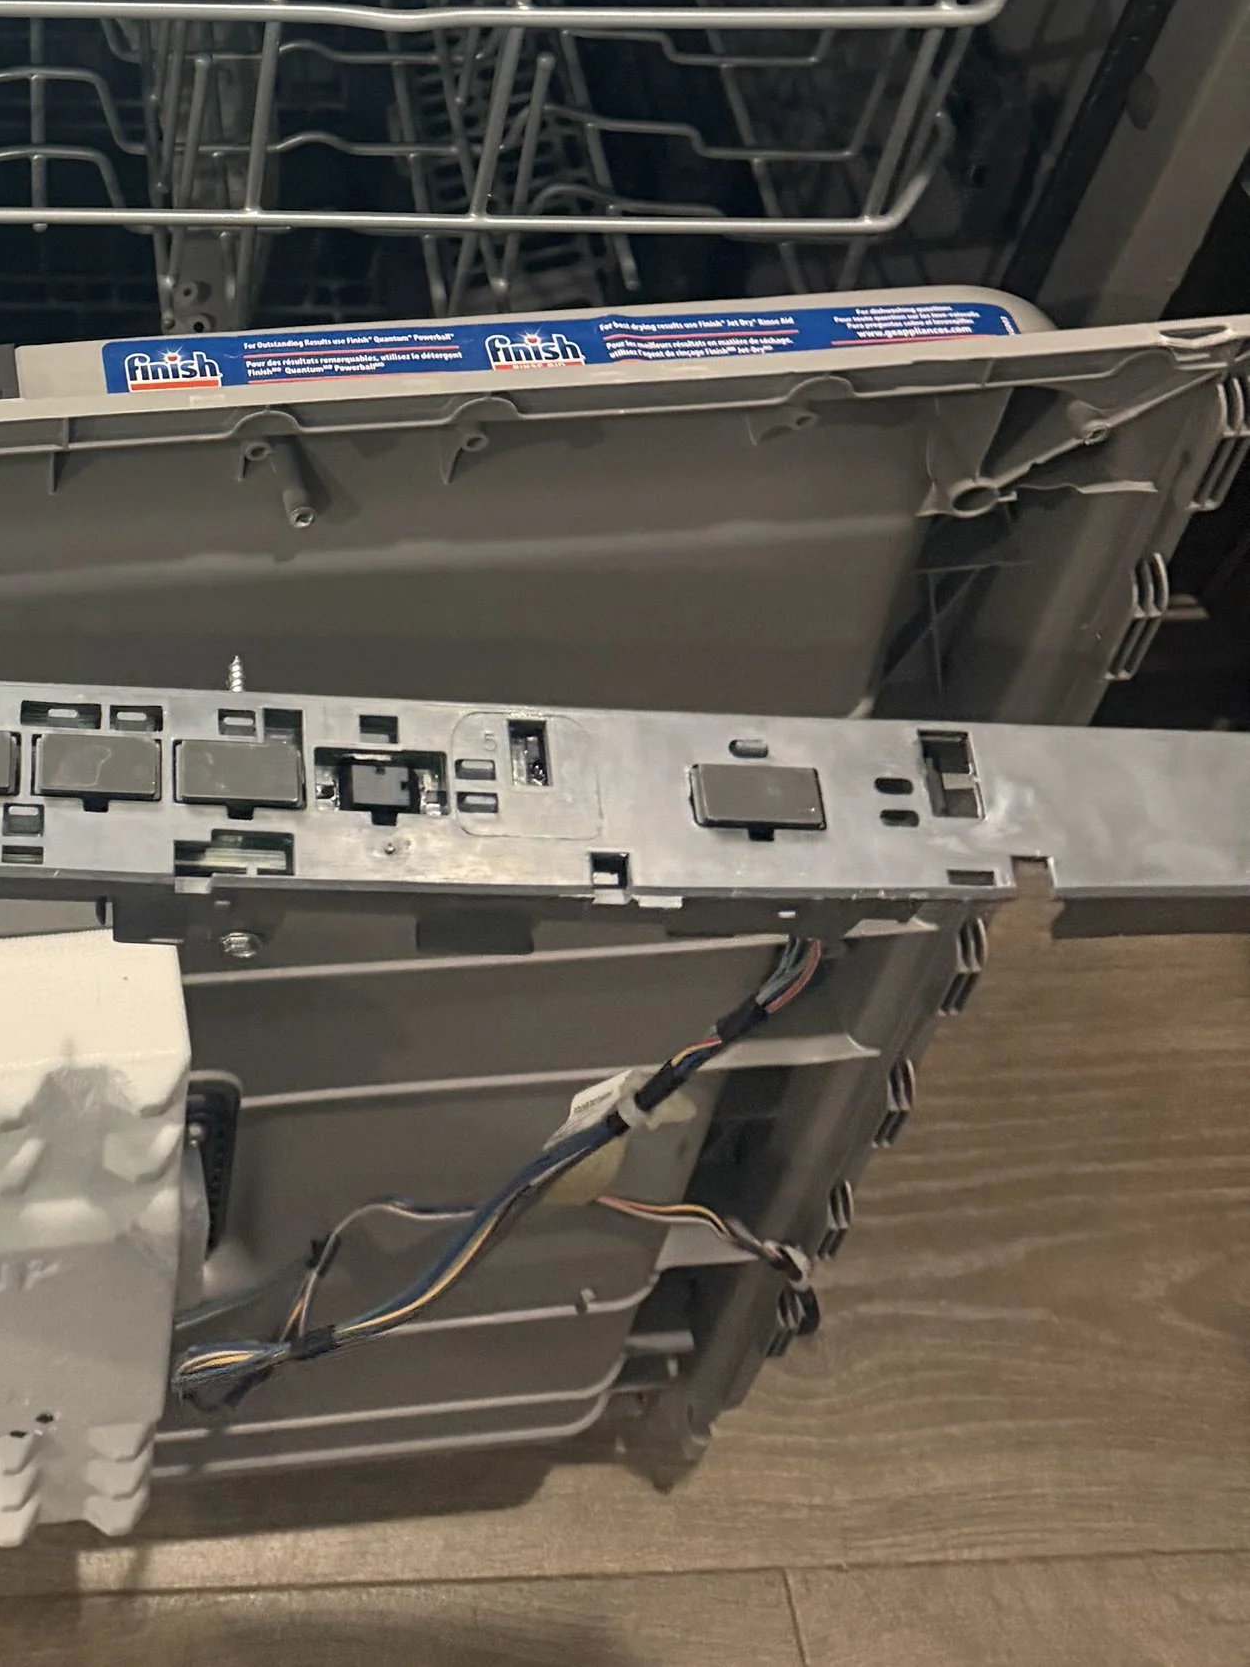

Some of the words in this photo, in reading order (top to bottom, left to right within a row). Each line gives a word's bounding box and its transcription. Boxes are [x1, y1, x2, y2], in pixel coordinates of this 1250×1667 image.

[915, 305, 953, 313] questions
[599, 323, 613, 331] For
[613, 321, 630, 330] best
[630, 323, 657, 332] drying
[657, 321, 684, 330] results
[684, 321, 698, 329] use
[756, 318, 780, 326] Rinse
[780, 316, 795, 325] Aid
[856, 326, 973, 338] www.geappliances.com
[243, 342, 257, 350] For
[256, 339, 304, 349] Outstanding
[304, 337, 332, 346] Results
[485, 334, 586, 363] finish
[606, 342, 626, 350] Pour
[636, 340, 673, 349] meilleurs
[672, 339, 707, 348] résultats
[748, 337, 760, 345] de
[246, 360, 266, 368] Pour
[266, 358, 282, 366] des
[282, 356, 319, 366] résultats
[380, 352, 411, 361] utilisez
[411, 352, 421, 360] le
[421, 351, 463, 361] détergent
[609, 349, 639, 359] utilisez
[664, 349, 676, 357] de
[125, 352, 222, 382] finish
